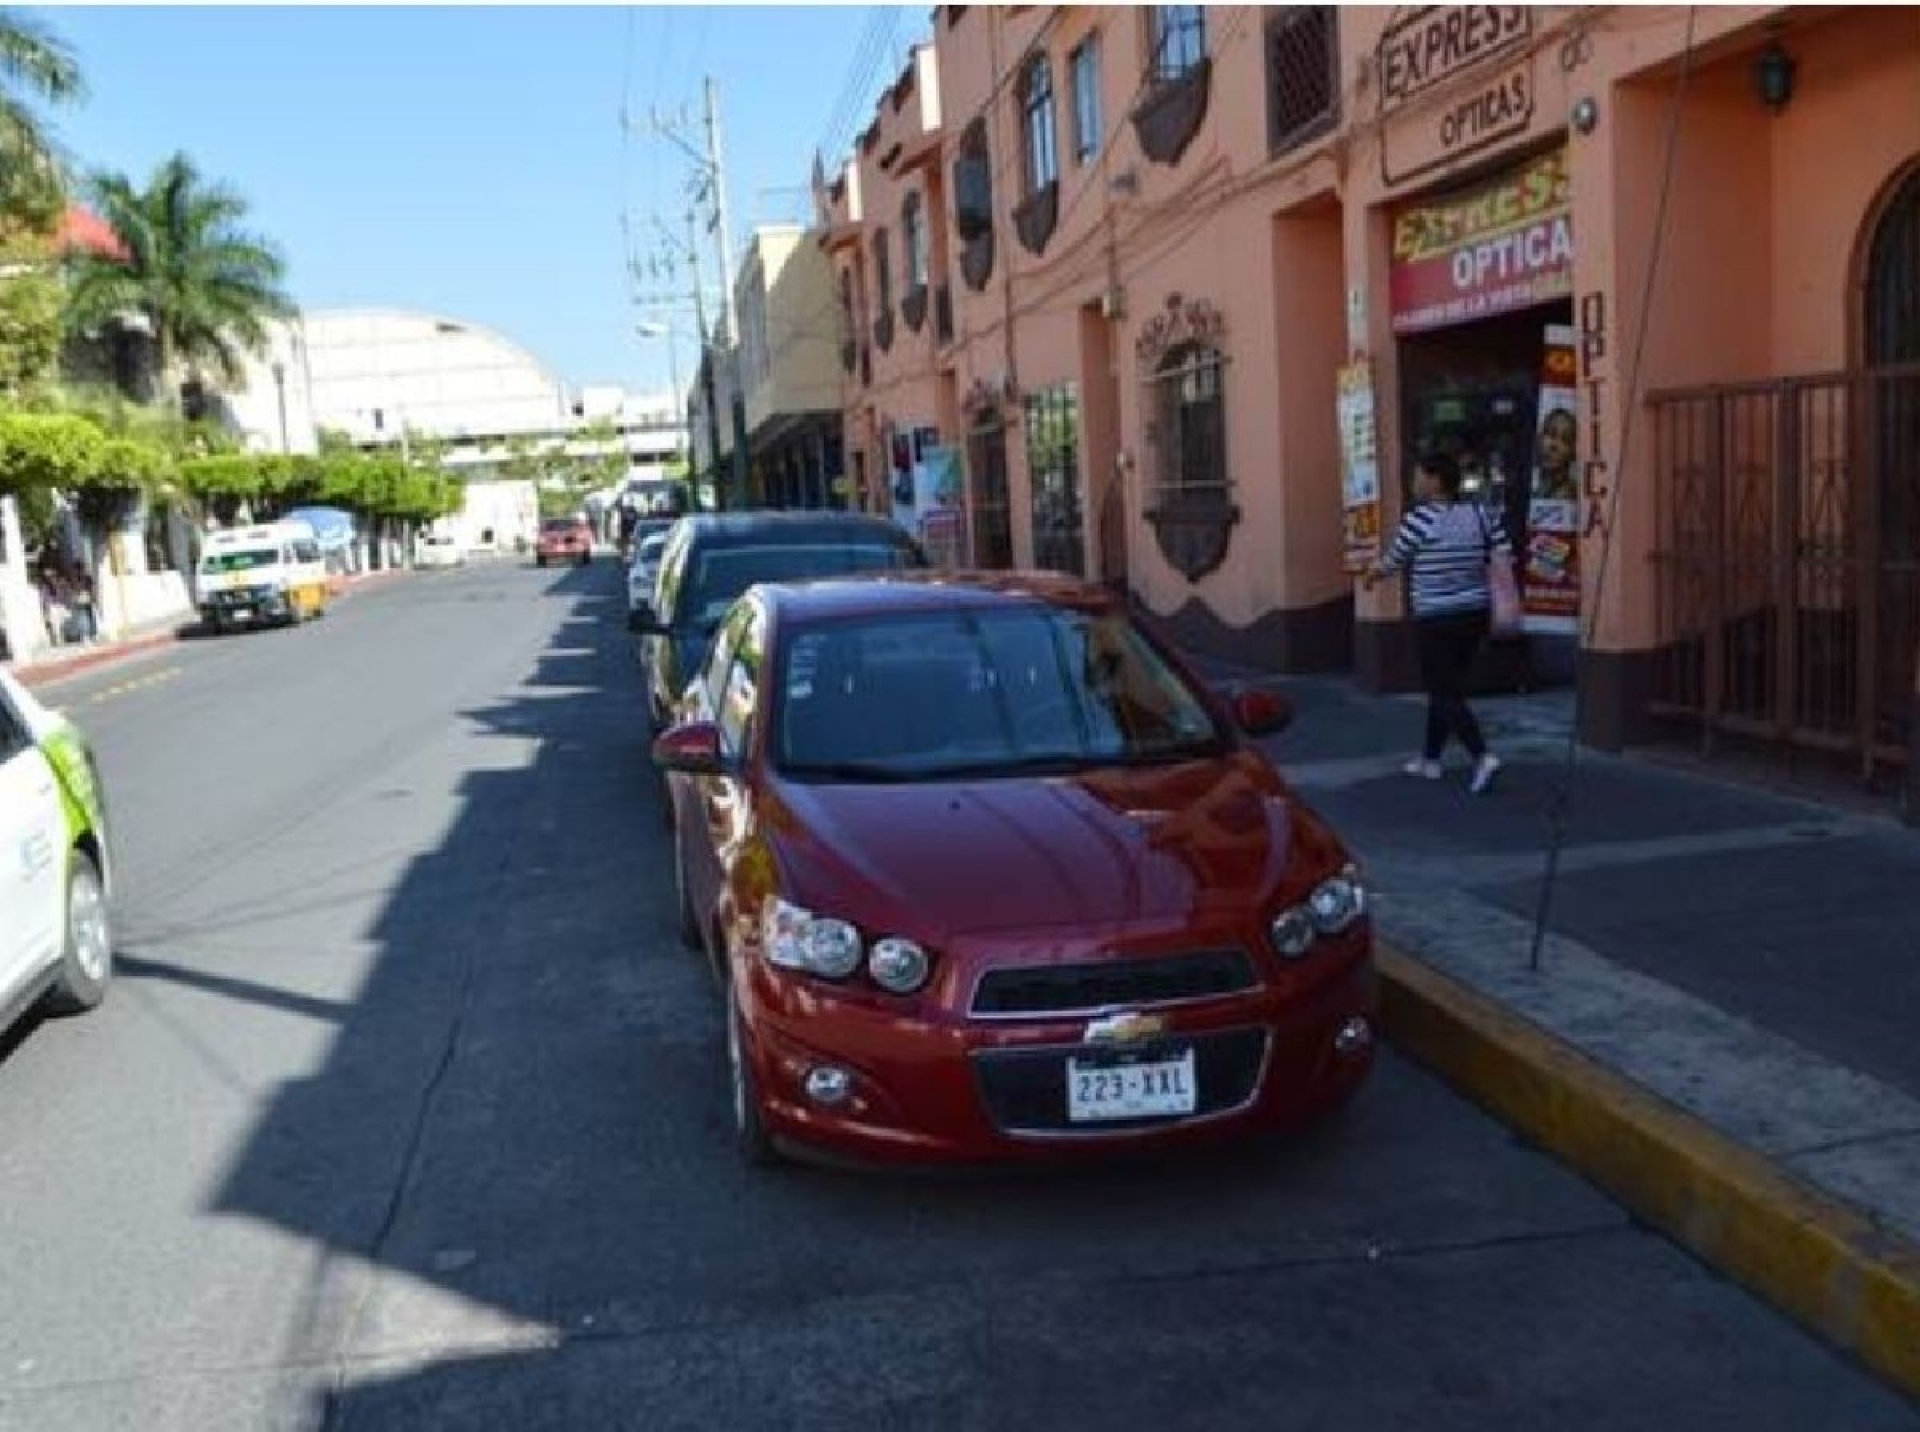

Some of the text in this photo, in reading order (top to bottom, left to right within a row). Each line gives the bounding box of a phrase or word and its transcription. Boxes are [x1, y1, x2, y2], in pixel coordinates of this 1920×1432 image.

[1440, 72, 1526, 147] OPTICAS
[1452, 218, 1572, 287] OPTICA
[1582, 291, 1608, 538] OPTICA
